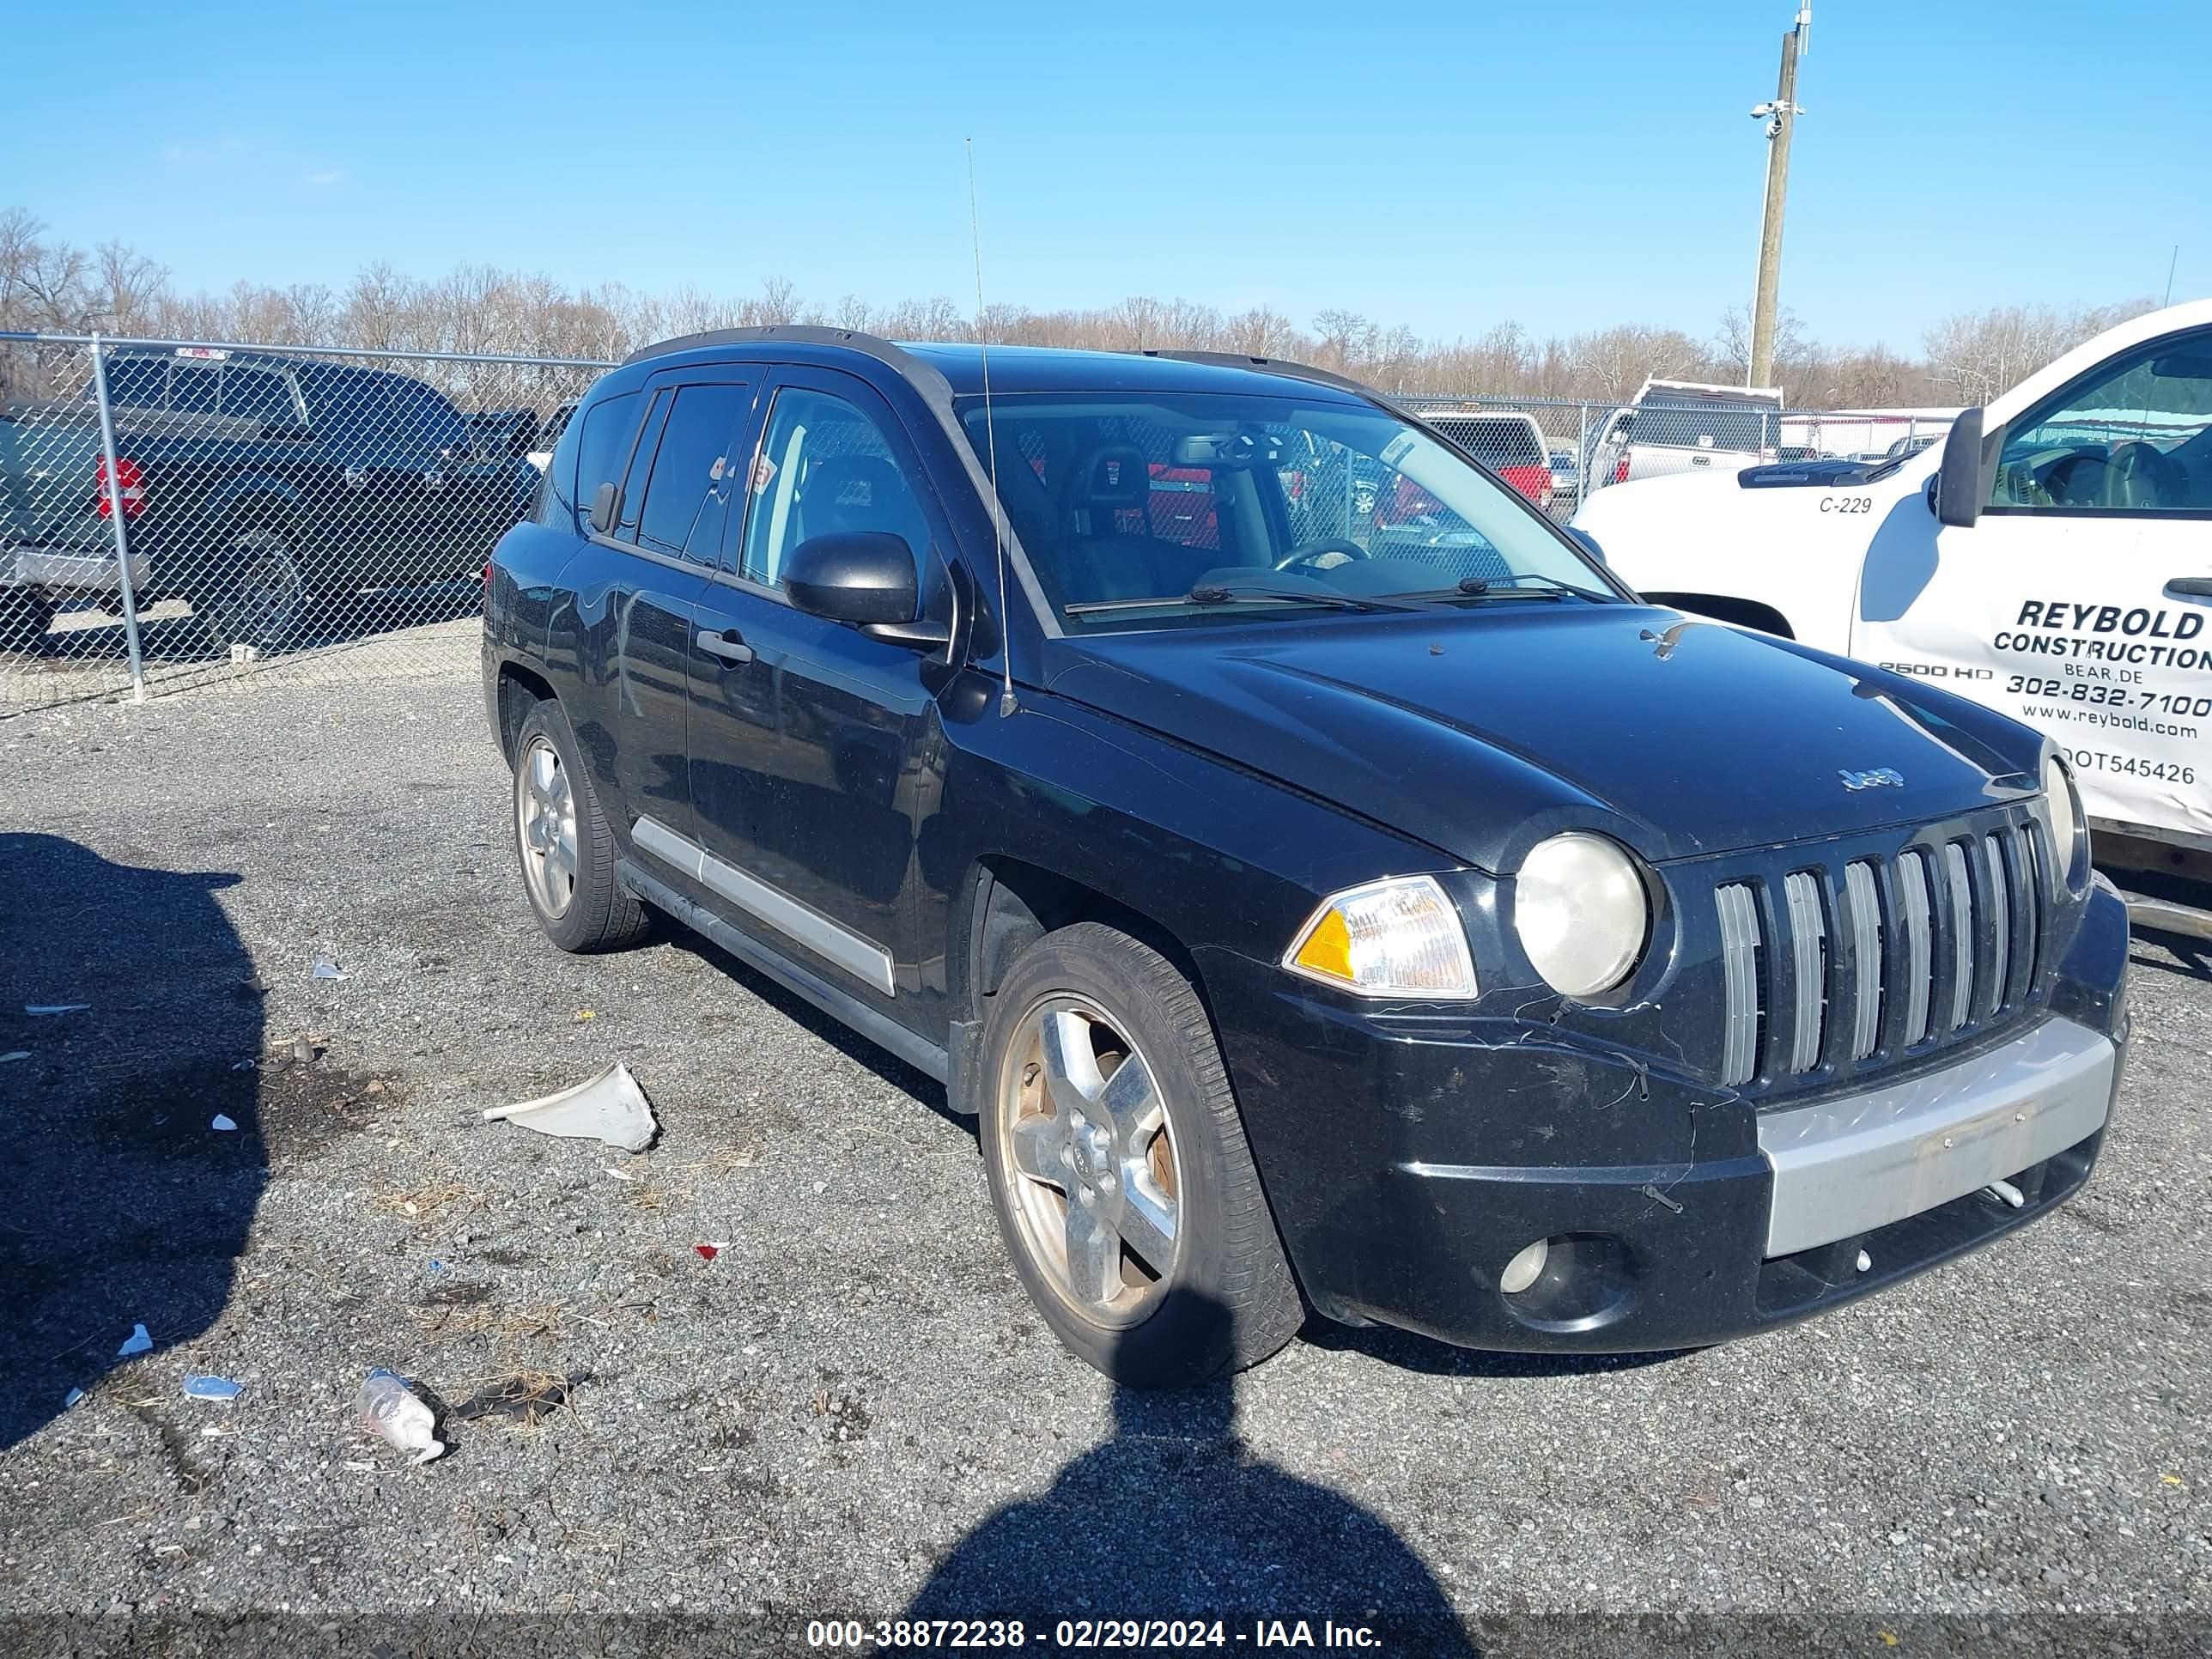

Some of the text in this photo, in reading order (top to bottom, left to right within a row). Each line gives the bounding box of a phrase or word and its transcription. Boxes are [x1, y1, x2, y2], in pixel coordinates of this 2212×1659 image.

[1820, 496, 1872, 514] C-229
[2016, 599, 2205, 640] REYBOLD
[1993, 631, 2212, 671] CONSTRUCTION
[1954, 666, 1994, 680] HD
[2006, 675, 2212, 717] 302-832-7100
[2022, 704, 2198, 739] www.reybold.com
[1838, 767, 1905, 792] Jeep
